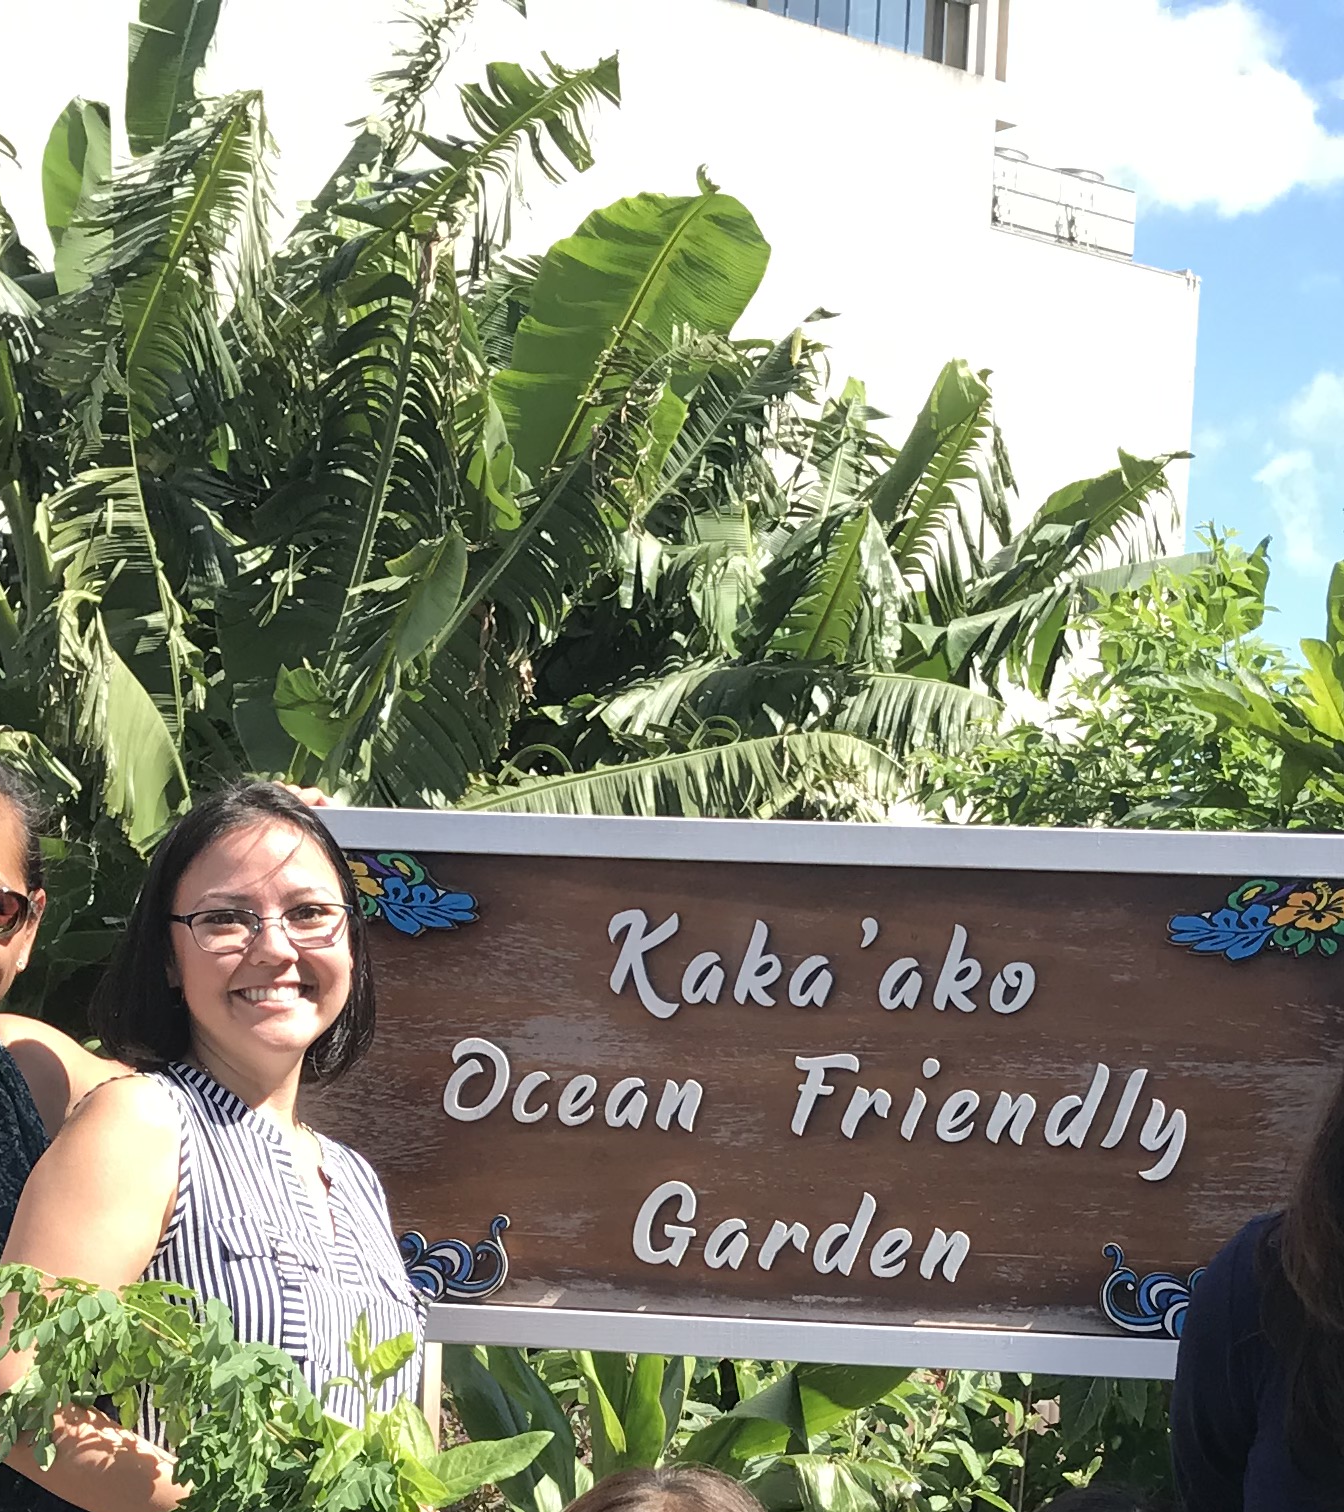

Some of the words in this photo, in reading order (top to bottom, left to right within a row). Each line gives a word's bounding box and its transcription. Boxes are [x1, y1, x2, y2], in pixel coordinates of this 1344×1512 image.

[606, 907, 1037, 1020] Kaka'ako
[440, 1035, 704, 1133] Ocean
[789, 1052, 1189, 1182] Friendly
[631, 1179, 972, 1284] Garden
